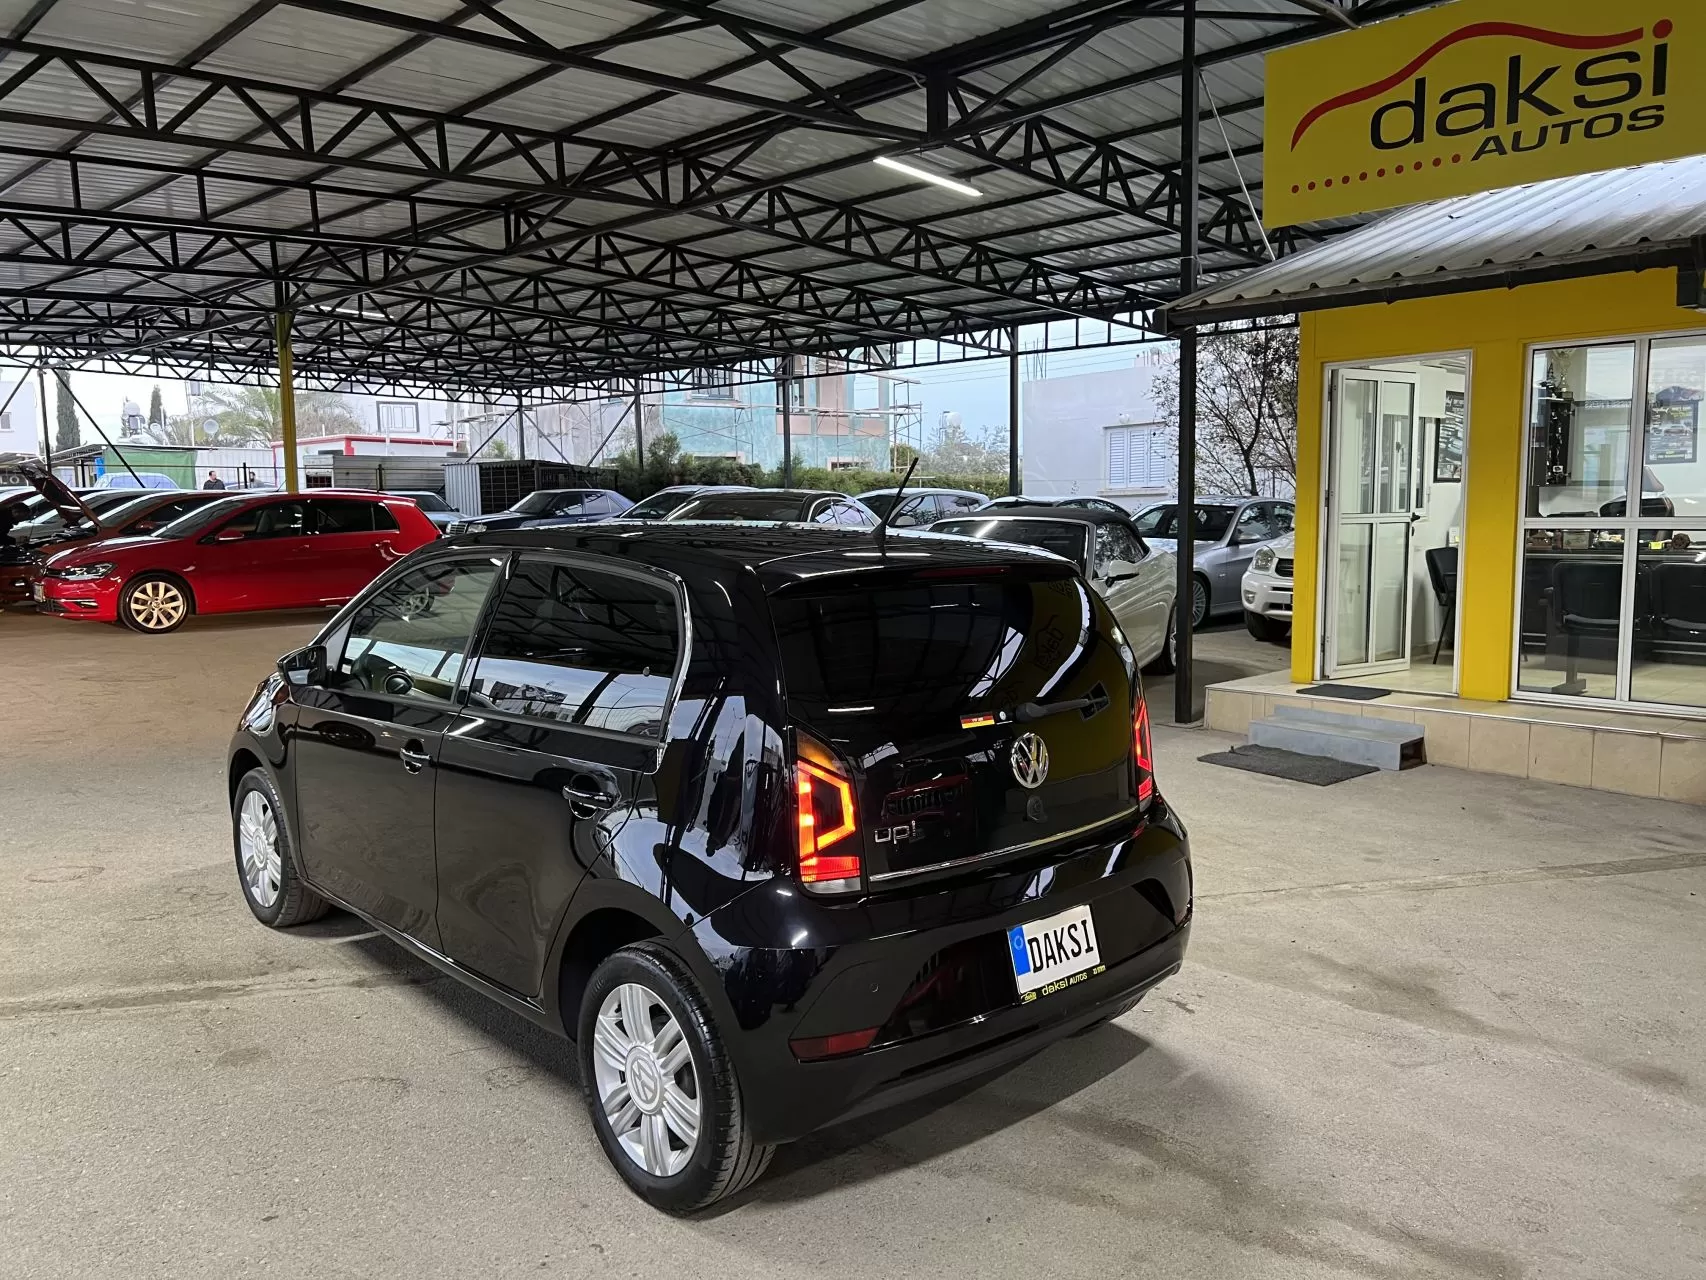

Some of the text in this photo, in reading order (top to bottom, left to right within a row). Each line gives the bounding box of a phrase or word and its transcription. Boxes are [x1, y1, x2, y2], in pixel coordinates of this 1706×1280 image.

[1370, 19, 1673, 150] daksi
[1470, 104, 1666, 161] AUTOS
[1028, 920, 1093, 973] DAKSI
[1069, 972, 1088, 985] AUTOS
